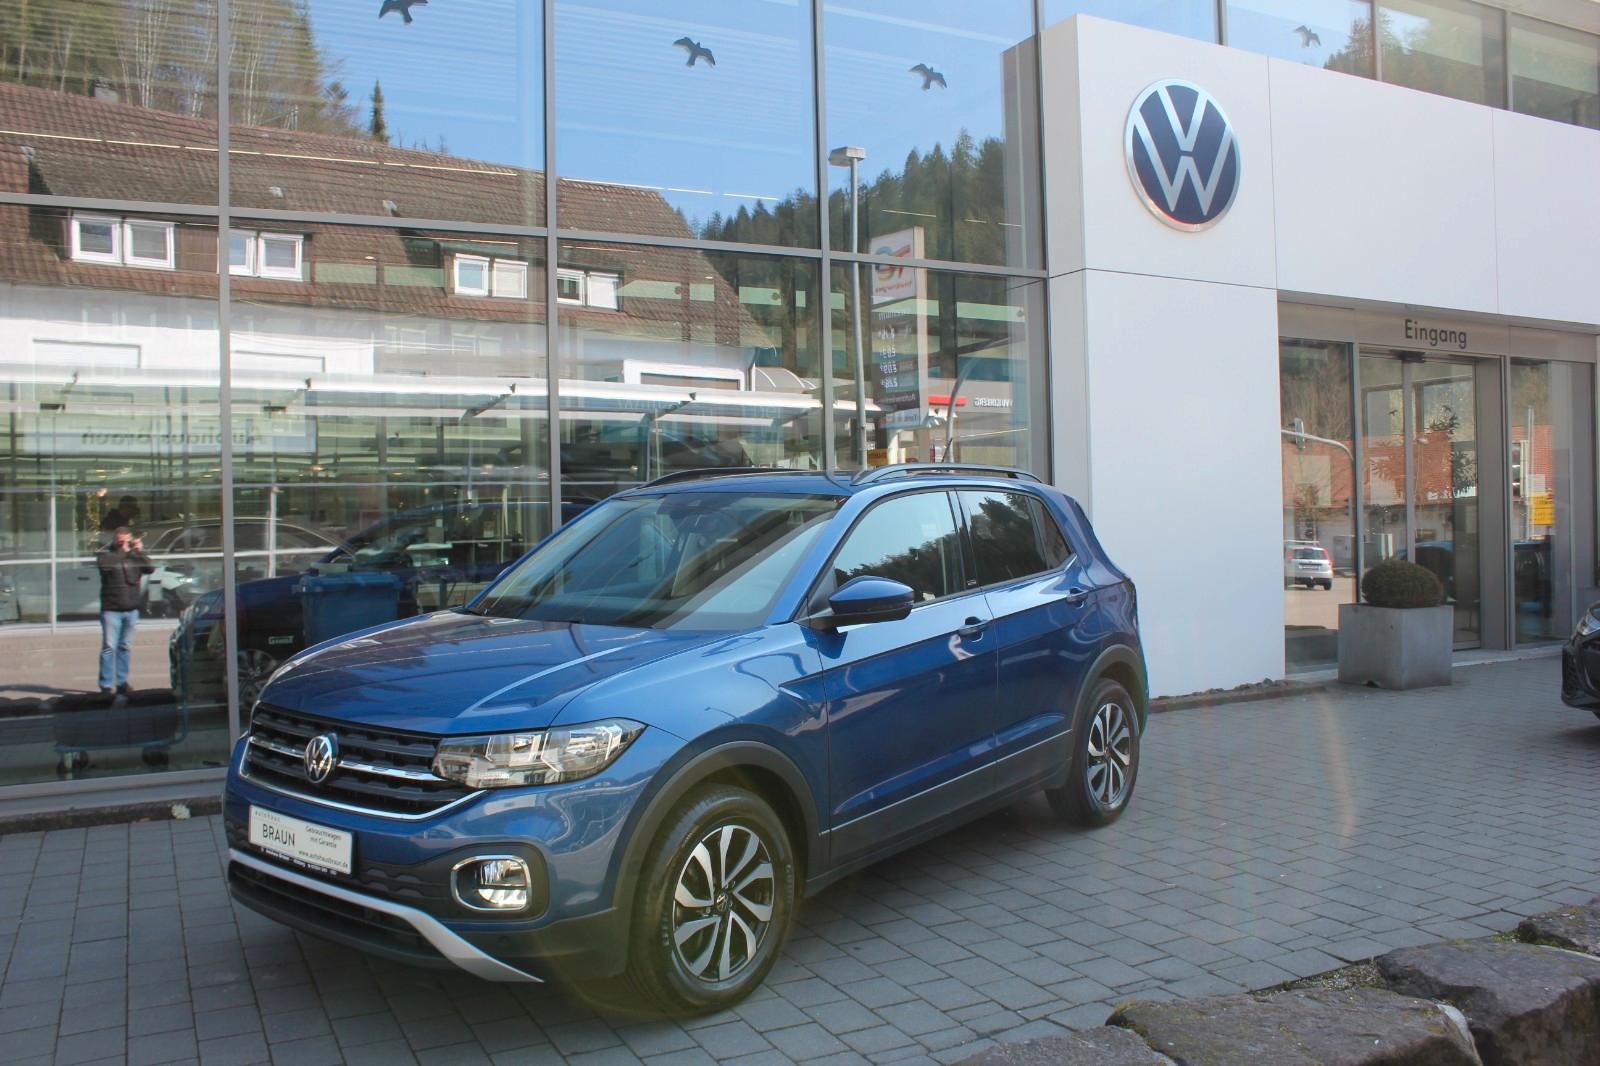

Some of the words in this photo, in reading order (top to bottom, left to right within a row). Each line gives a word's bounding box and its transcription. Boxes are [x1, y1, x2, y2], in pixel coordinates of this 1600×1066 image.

[1126, 80, 1240, 231] VW
[1405, 319, 1466, 349] Eingang
[262, 823, 295, 847] BRAUN
